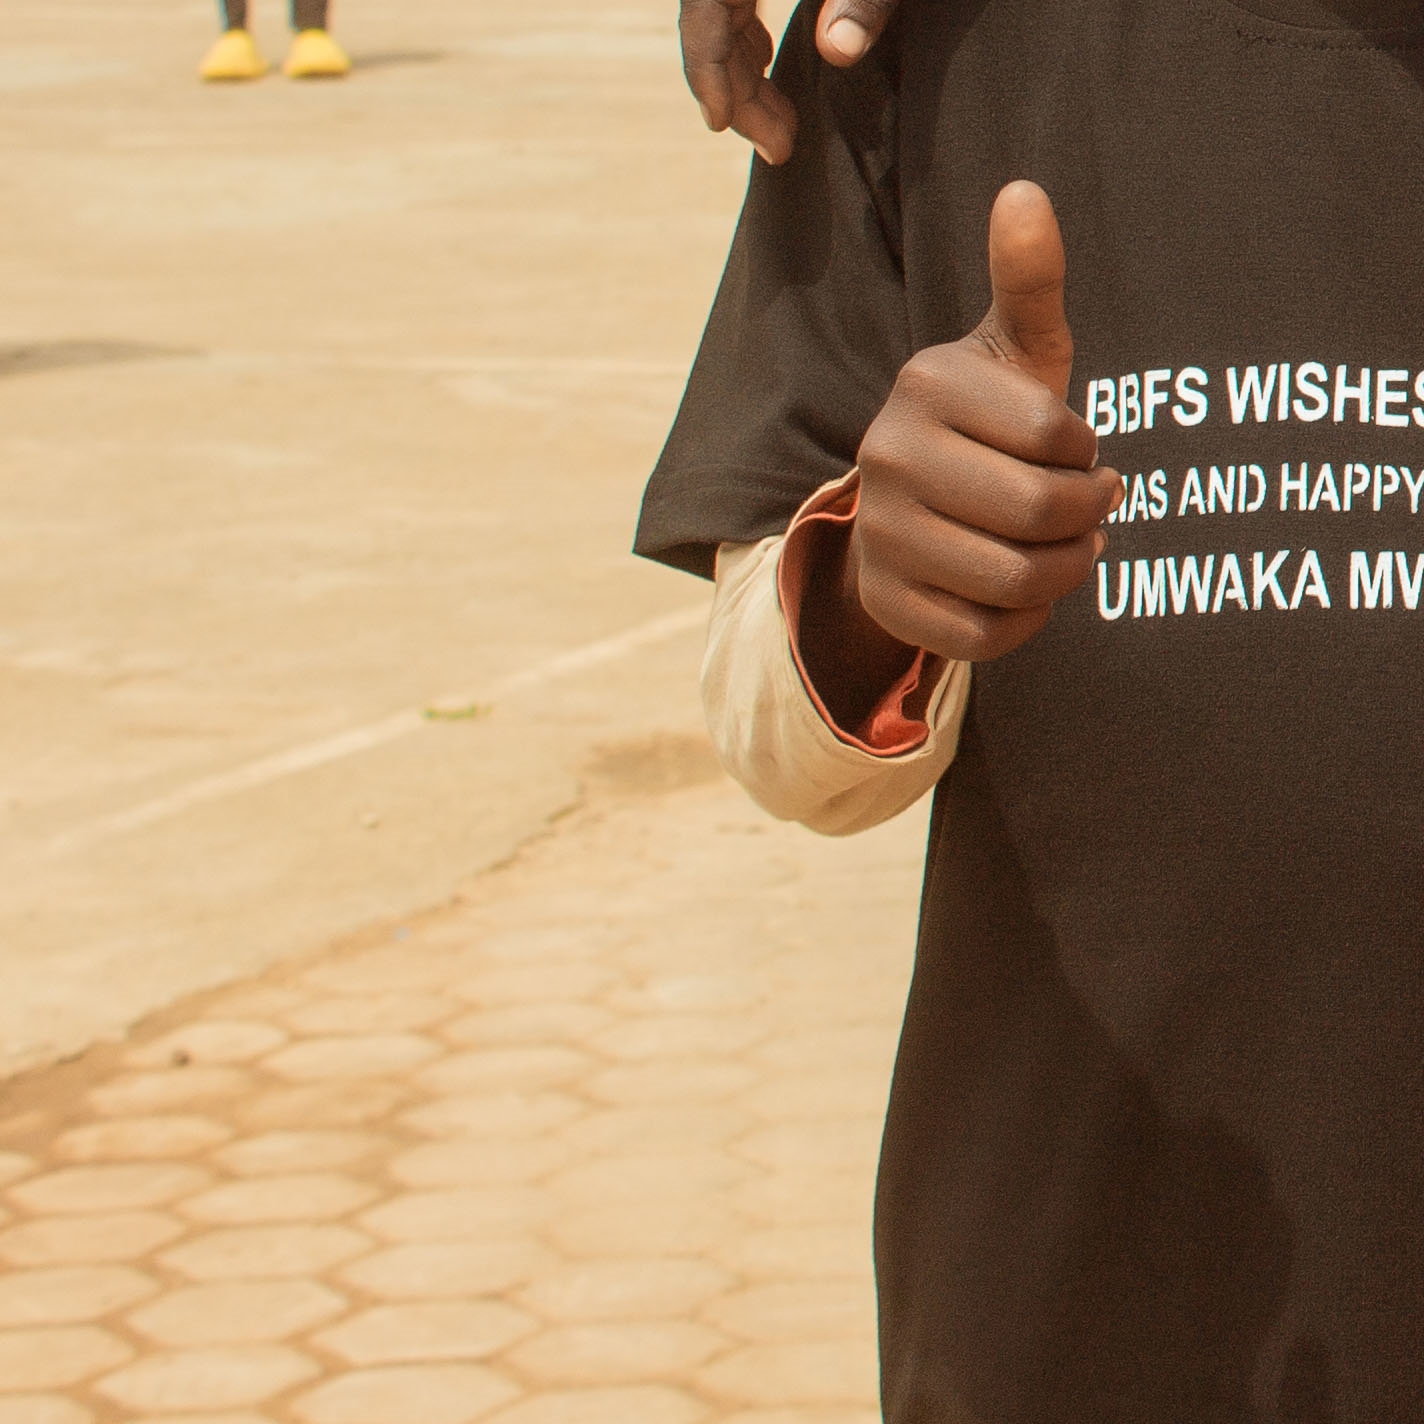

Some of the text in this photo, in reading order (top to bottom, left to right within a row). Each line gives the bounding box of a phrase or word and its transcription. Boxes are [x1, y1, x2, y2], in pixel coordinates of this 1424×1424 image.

[1085, 366, 1208, 437] BBFS
[1178, 464, 1267, 517] AND
[1097, 549, 1331, 621] UMWAKA
